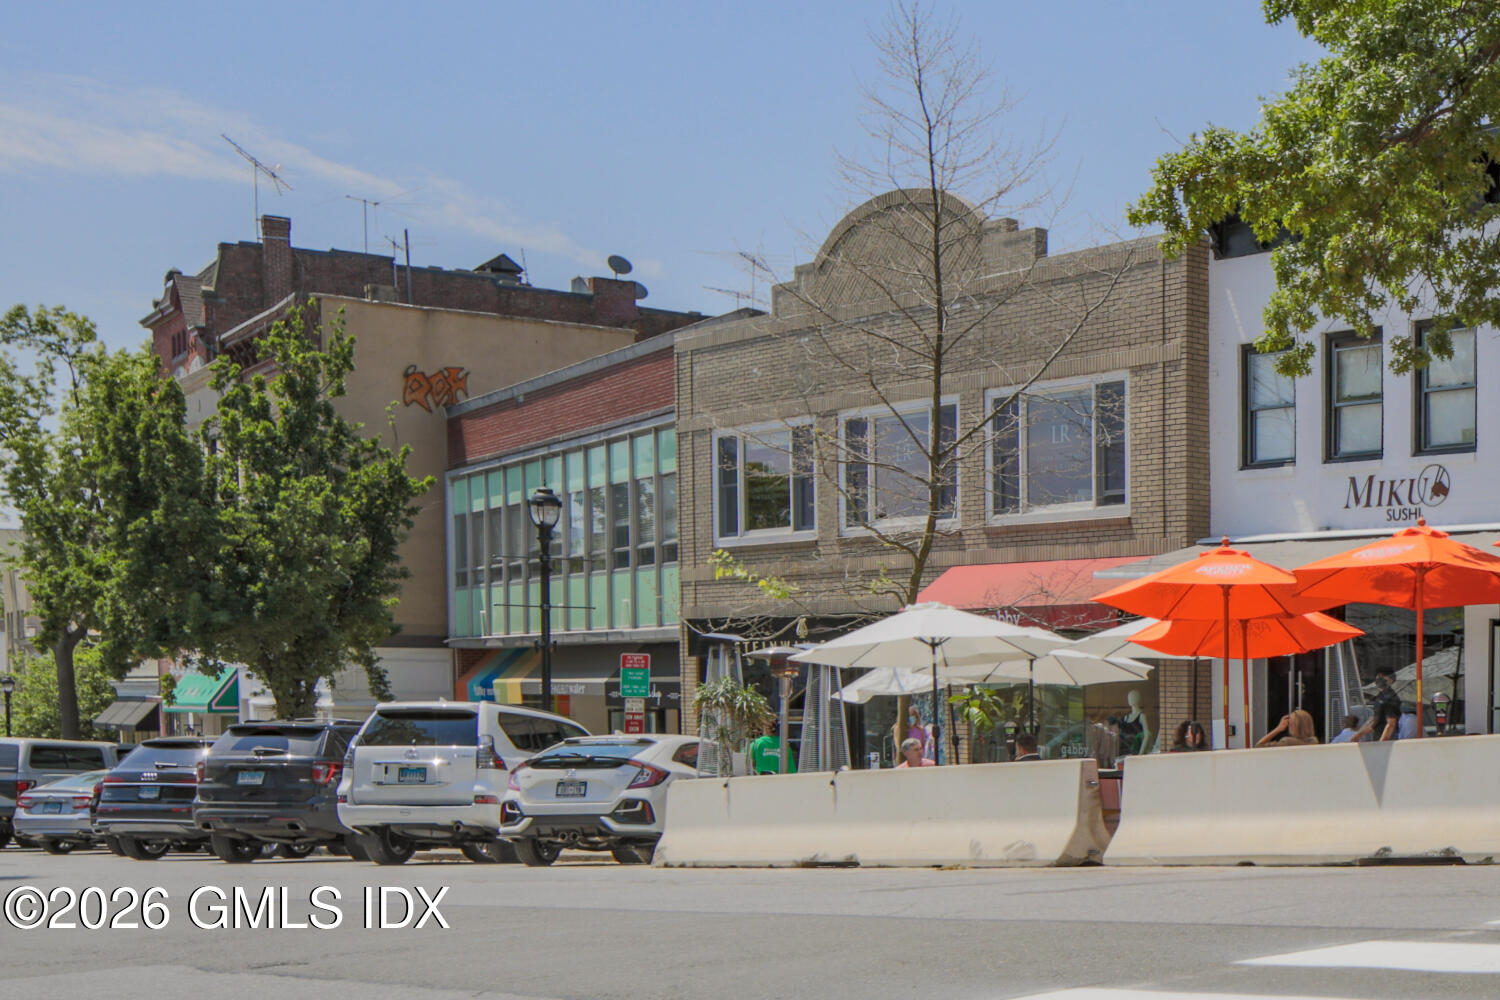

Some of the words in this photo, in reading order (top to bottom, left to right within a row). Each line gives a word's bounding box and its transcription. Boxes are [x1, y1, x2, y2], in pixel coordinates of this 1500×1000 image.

[1343, 474, 1429, 509] MIKU
[1386, 507, 1421, 521] SUSHI
[1061, 742, 1089, 758] gabby
